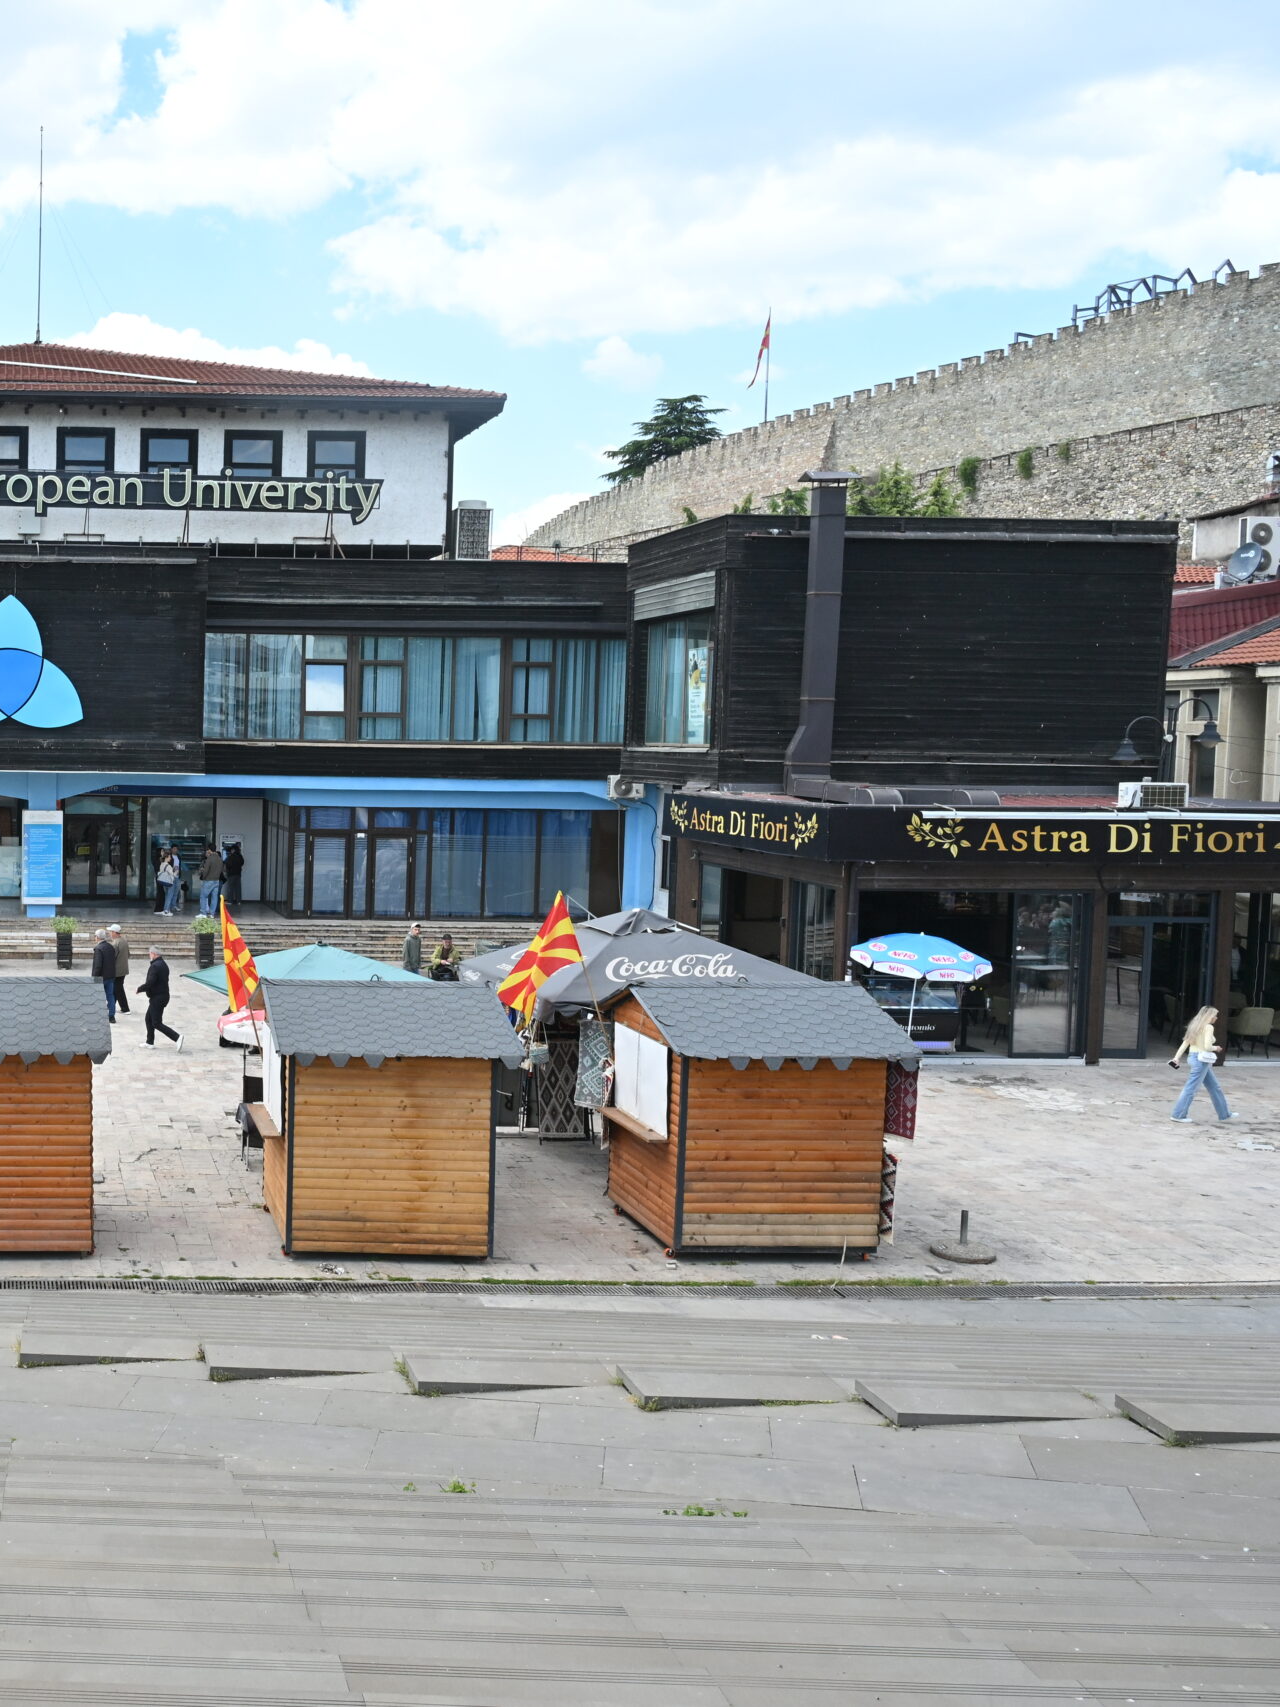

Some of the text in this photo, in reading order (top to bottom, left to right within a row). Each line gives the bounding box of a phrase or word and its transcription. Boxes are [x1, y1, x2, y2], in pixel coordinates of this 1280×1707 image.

[163, 468, 381, 524] University
[689, 807, 788, 843] Astra Di Fiori
[977, 822, 1267, 853] Astra Di Fiori
[605, 952, 738, 983] Coca-Cola
